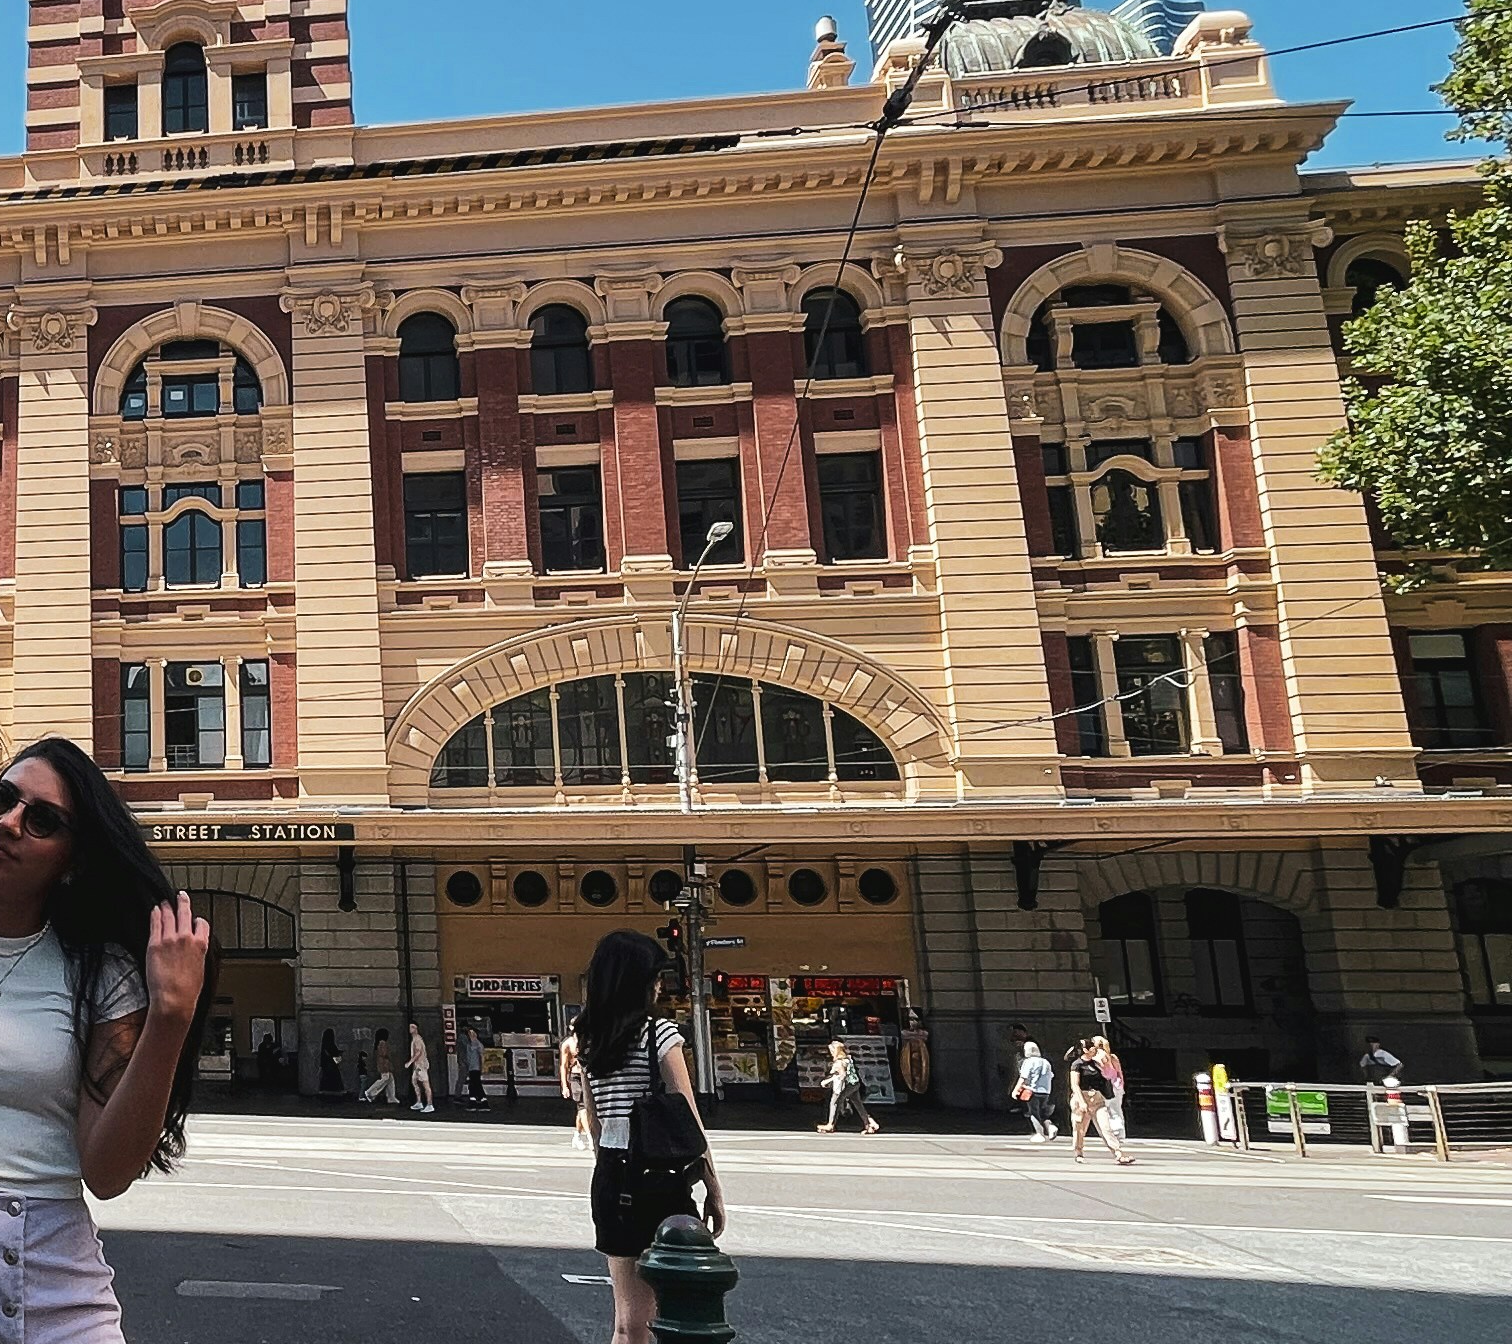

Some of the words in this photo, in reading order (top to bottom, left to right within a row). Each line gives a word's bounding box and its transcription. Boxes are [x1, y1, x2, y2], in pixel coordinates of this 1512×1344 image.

[153, 825, 222, 840] STREET
[251, 824, 336, 839] STATION
[469, 980, 500, 991] LORD
[510, 980, 542, 992] FRIES
